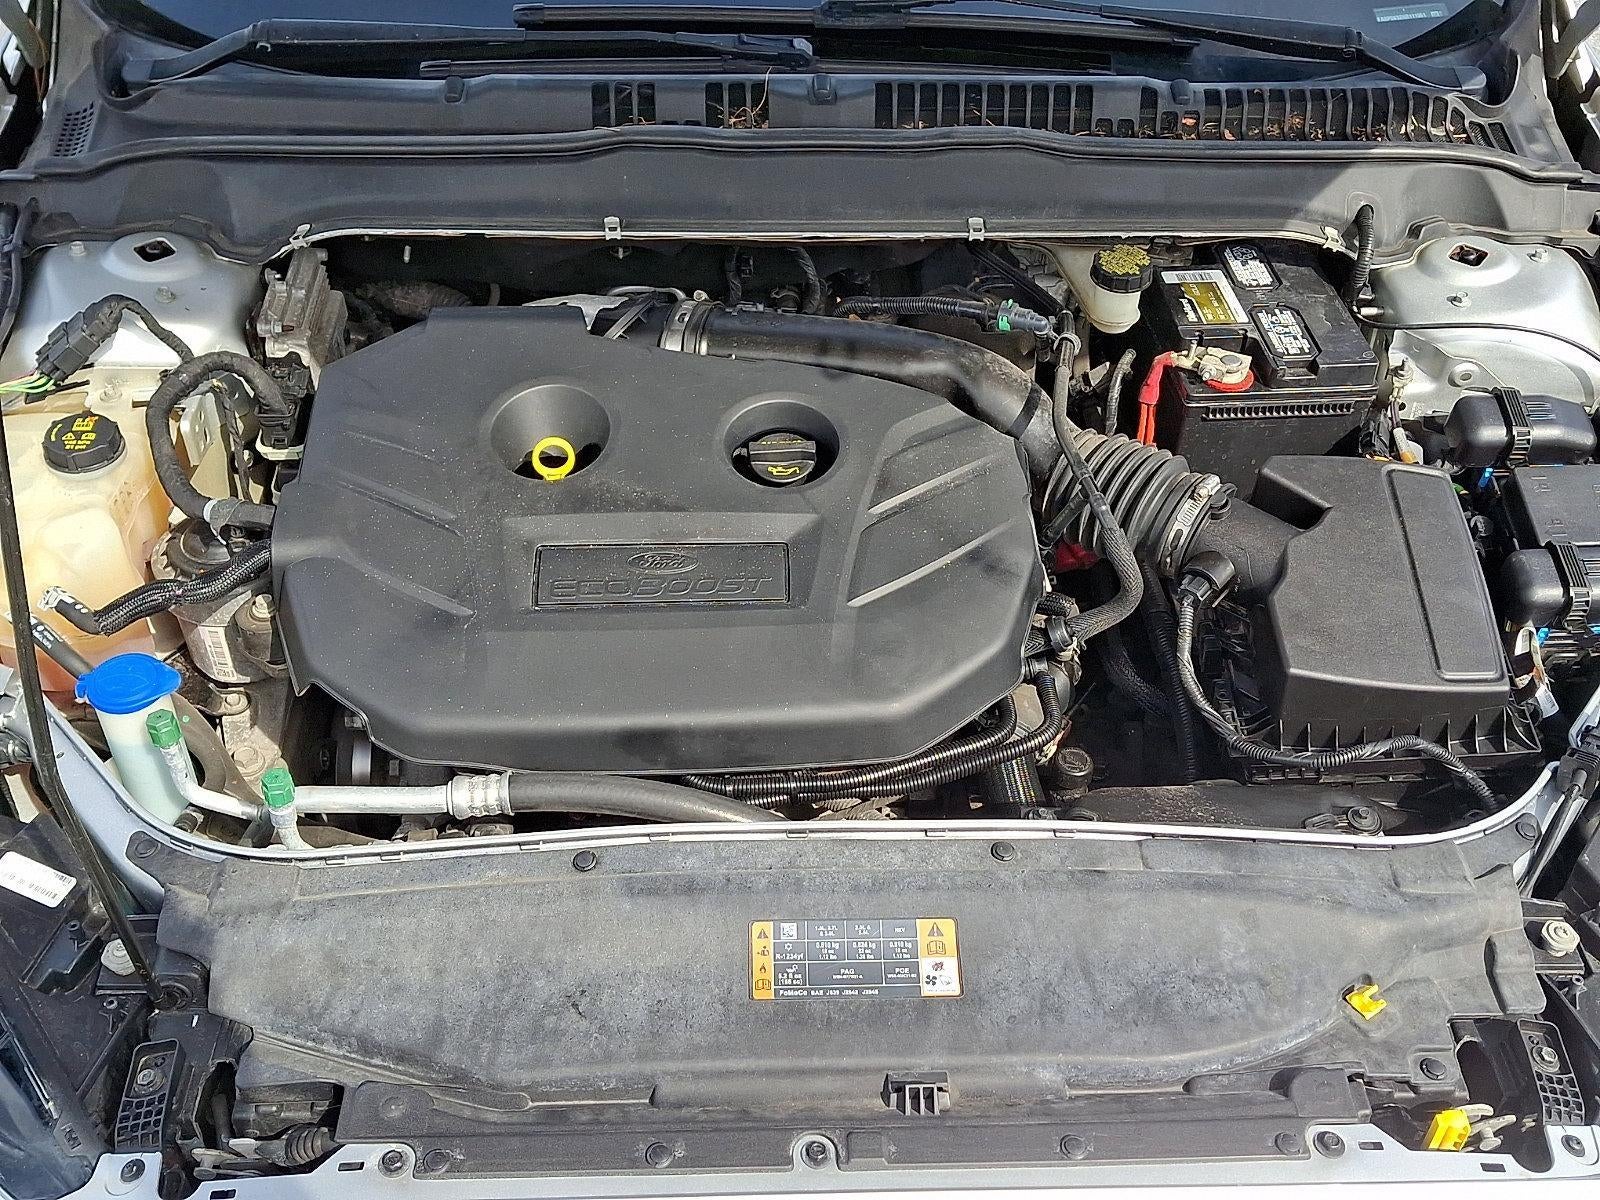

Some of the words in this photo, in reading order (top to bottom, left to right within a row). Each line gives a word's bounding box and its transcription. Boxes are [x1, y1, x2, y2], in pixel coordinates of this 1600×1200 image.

[637, 553, 685, 570] Ford
[551, 576, 773, 600] ECOBOOST
[775, 952, 804, 960] R-1234yf
